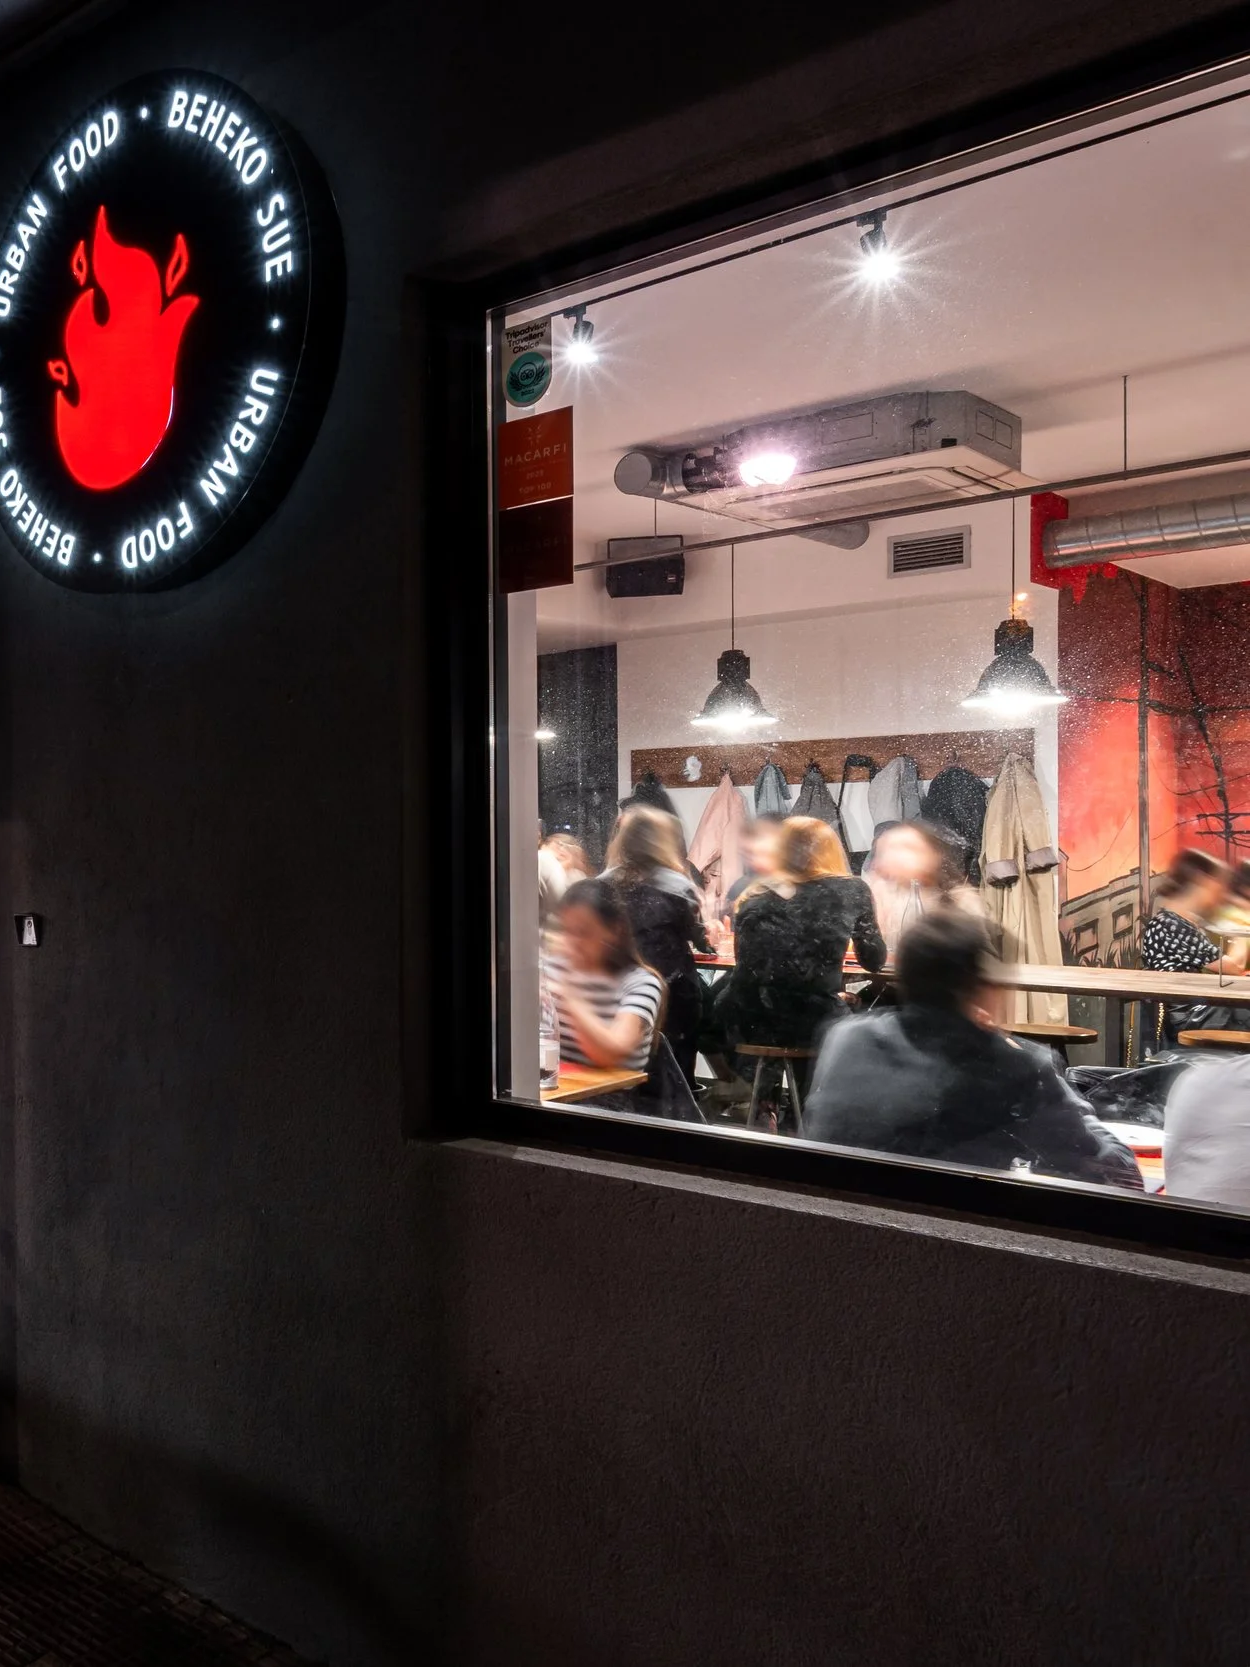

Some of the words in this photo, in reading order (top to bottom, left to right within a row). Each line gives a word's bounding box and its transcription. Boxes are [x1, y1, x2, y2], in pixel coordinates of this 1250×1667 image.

[52, 110, 120, 191] FOOD
[167, 90, 269, 185] BEHEKO
[256, 193, 293, 282] SUE
[505, 321, 548, 340] Tripadvisor
[200, 368, 279, 506] URBAN
[504, 443, 567, 467] MACARFI
[0, 468, 76, 566] BEHEKO
[121, 501, 194, 569] FOOD
